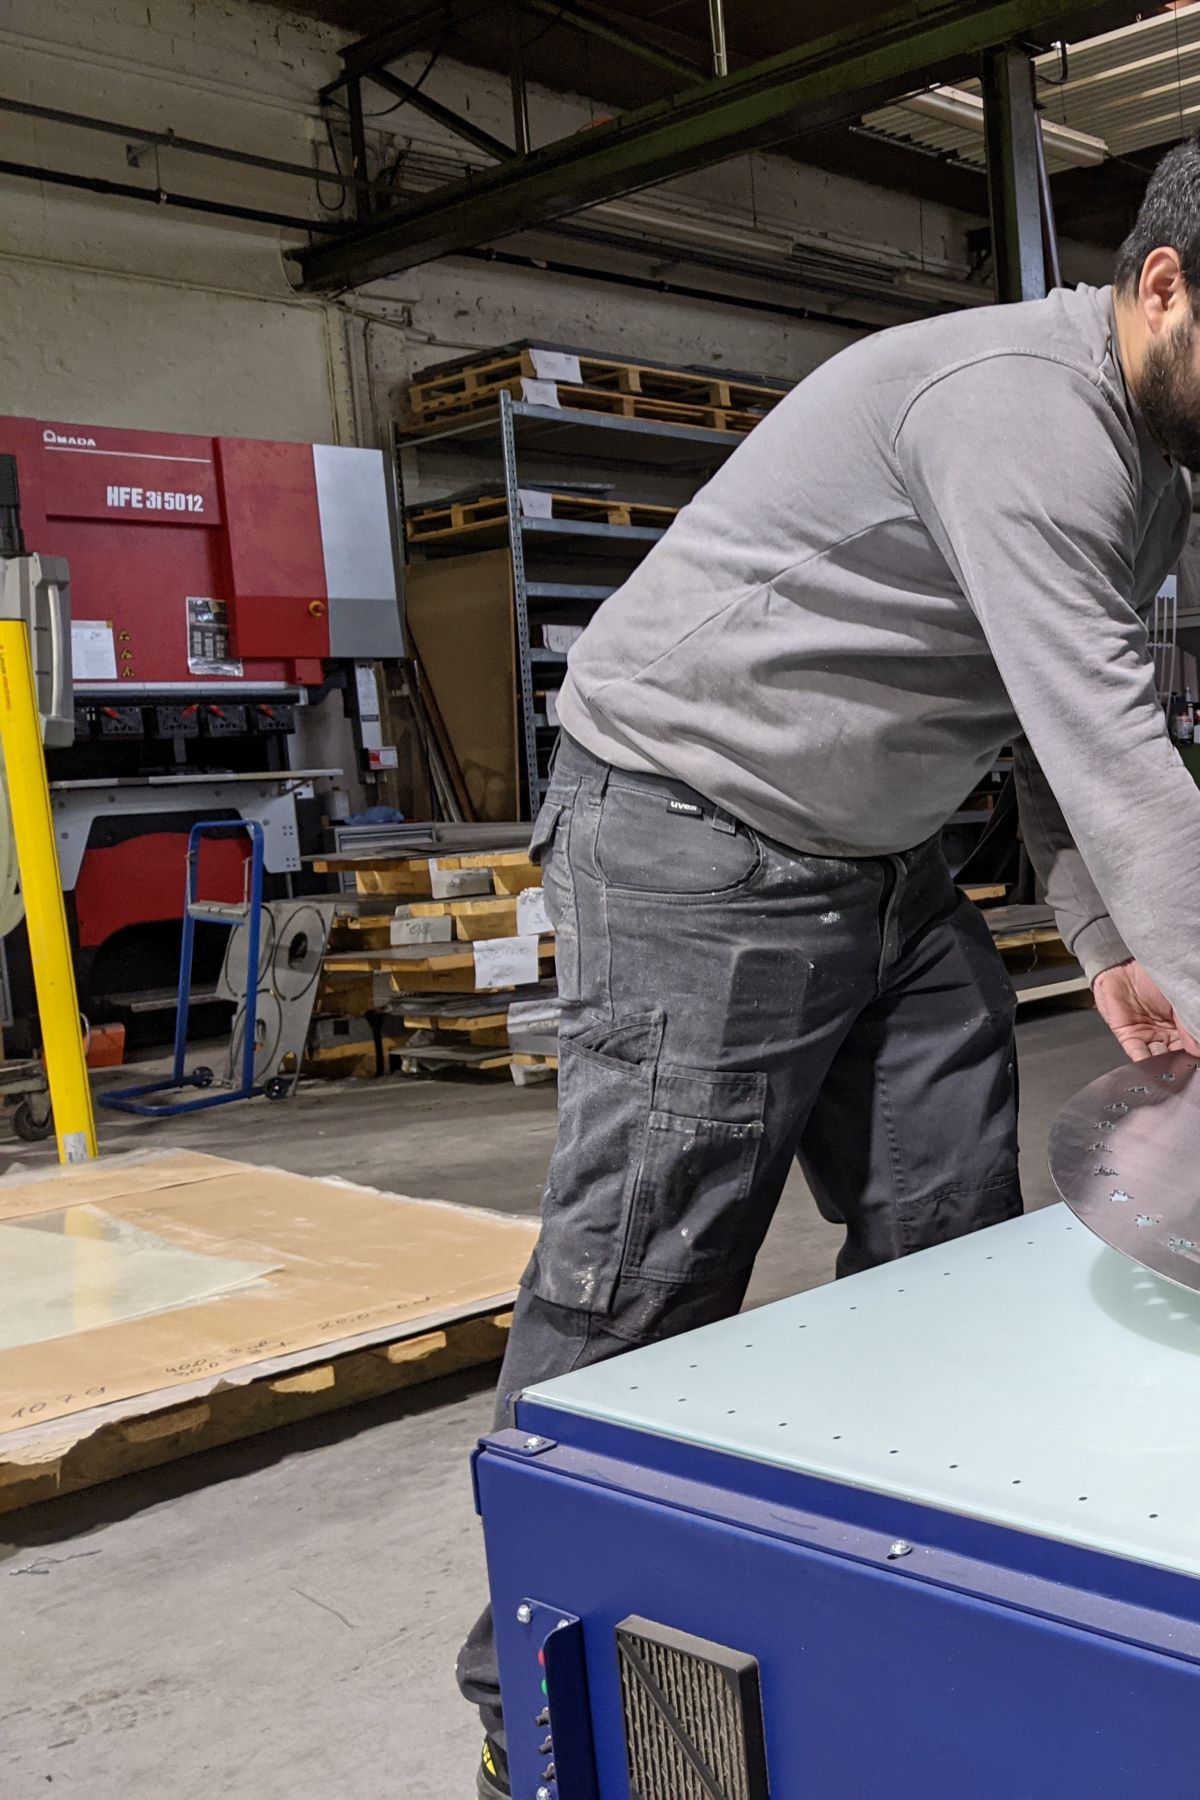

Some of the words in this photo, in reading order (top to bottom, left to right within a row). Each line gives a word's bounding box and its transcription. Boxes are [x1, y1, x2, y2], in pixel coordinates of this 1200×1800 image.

[43, 430, 96, 447] AMADA
[107, 486, 144, 508] HFE
[146, 491, 162, 510] 3i
[164, 494, 204, 512] 5012
[670, 801, 698, 811] uvex
